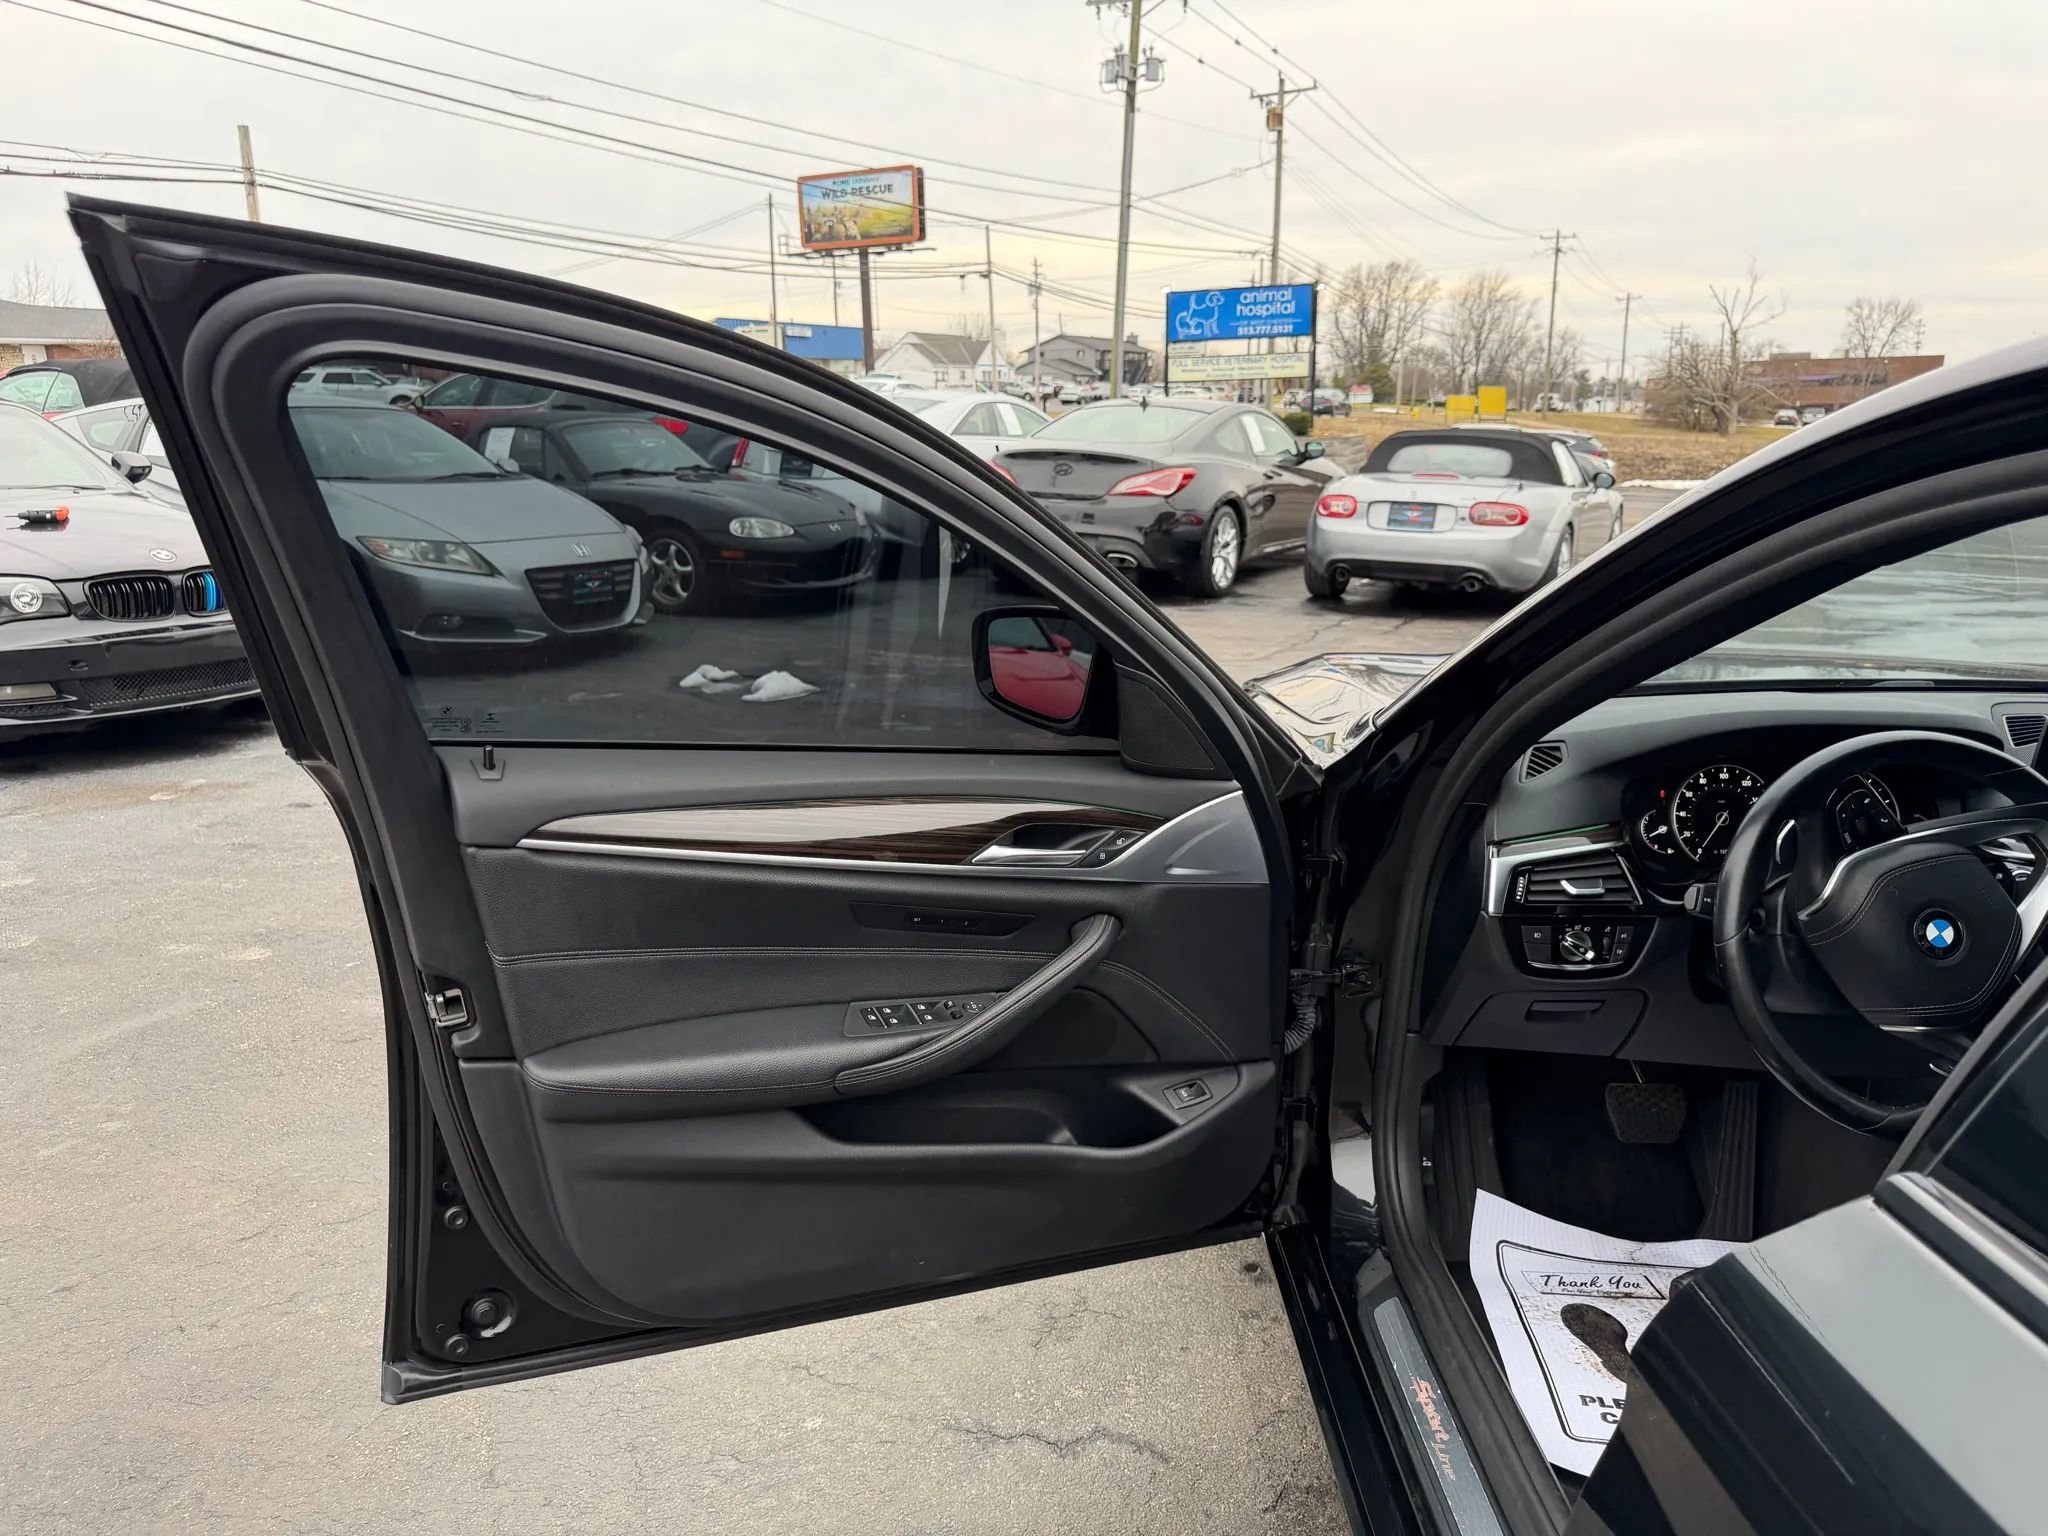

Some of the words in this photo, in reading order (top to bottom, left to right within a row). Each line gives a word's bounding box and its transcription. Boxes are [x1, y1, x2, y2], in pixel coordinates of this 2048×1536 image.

[821, 188, 848, 200] WILD
[850, 183, 894, 196] RESCUE
[1239, 287, 1293, 304] animal
[1236, 300, 1296, 317] hospital
[1192, 358, 1222, 367] SERVICE
[1540, 1273, 1604, 1289] Thank
[1608, 1275, 1644, 1291] You
[1578, 1394, 1626, 1410] PLE
